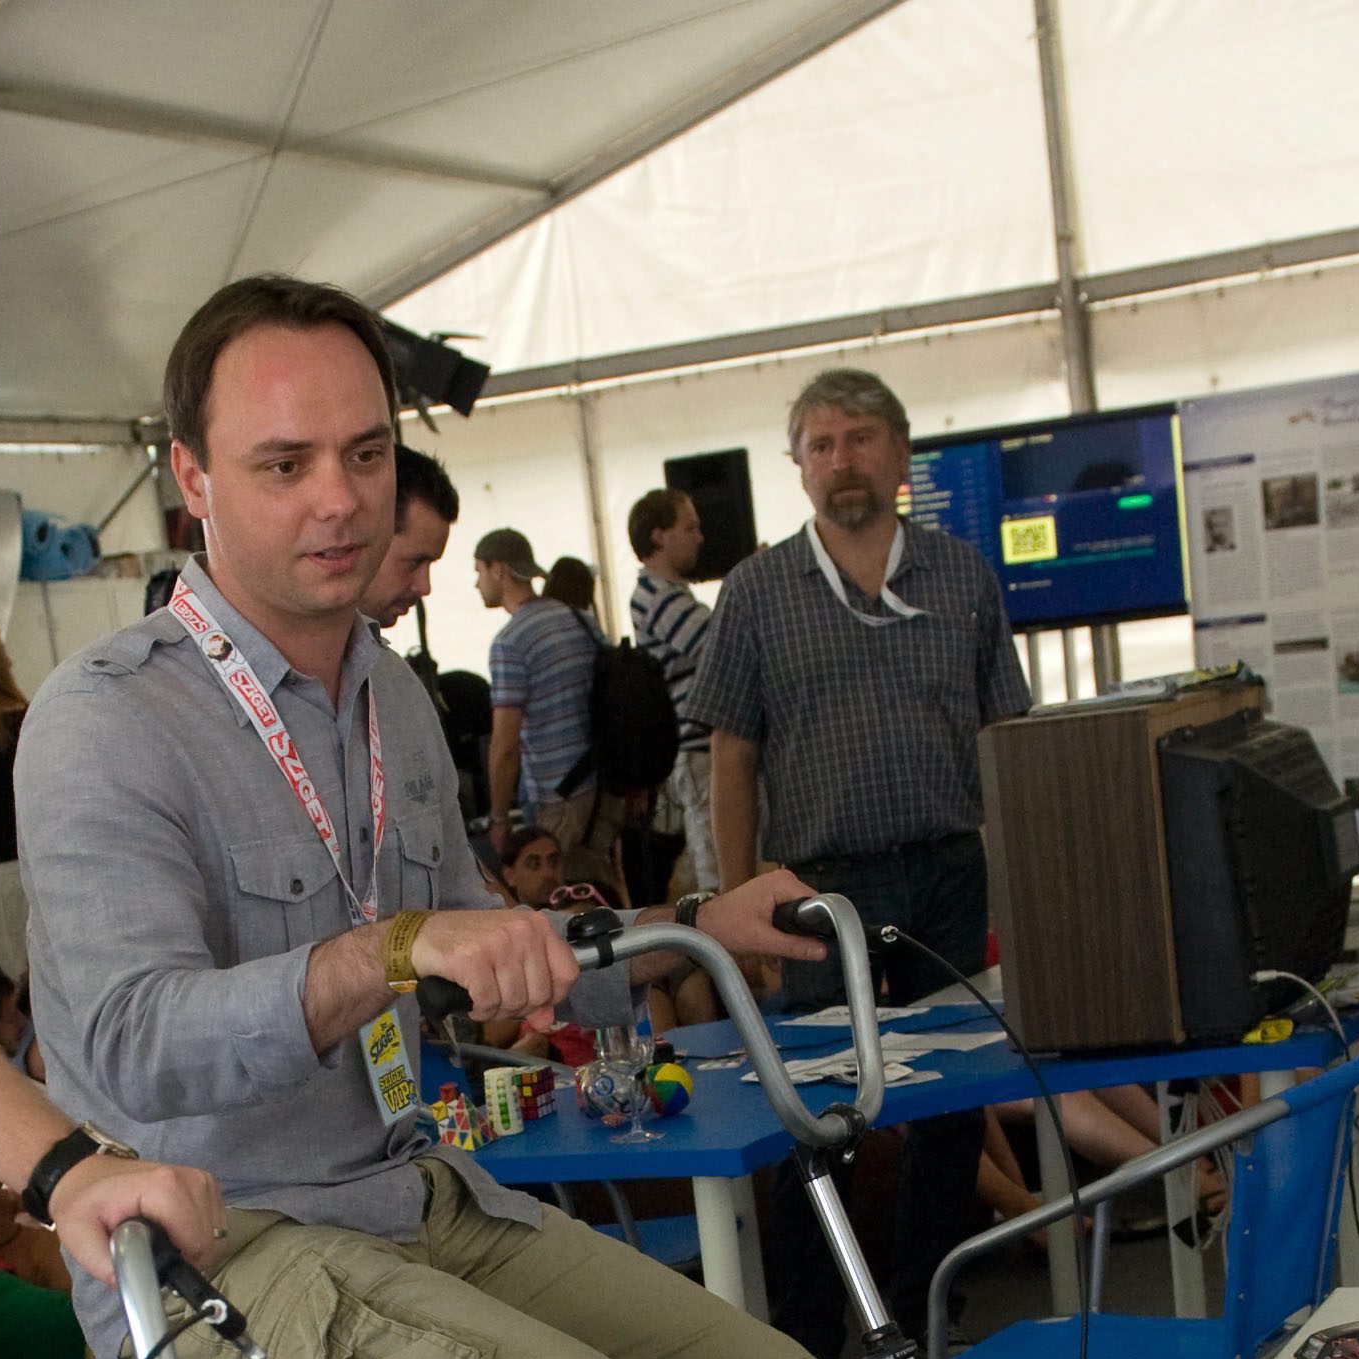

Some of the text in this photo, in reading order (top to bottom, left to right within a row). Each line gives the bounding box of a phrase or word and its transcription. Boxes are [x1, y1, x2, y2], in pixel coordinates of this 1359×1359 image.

[229, 670, 277, 728] SZIGET
[268, 729, 331, 841] SZIGET
[382, 1080, 412, 1114] VIP
